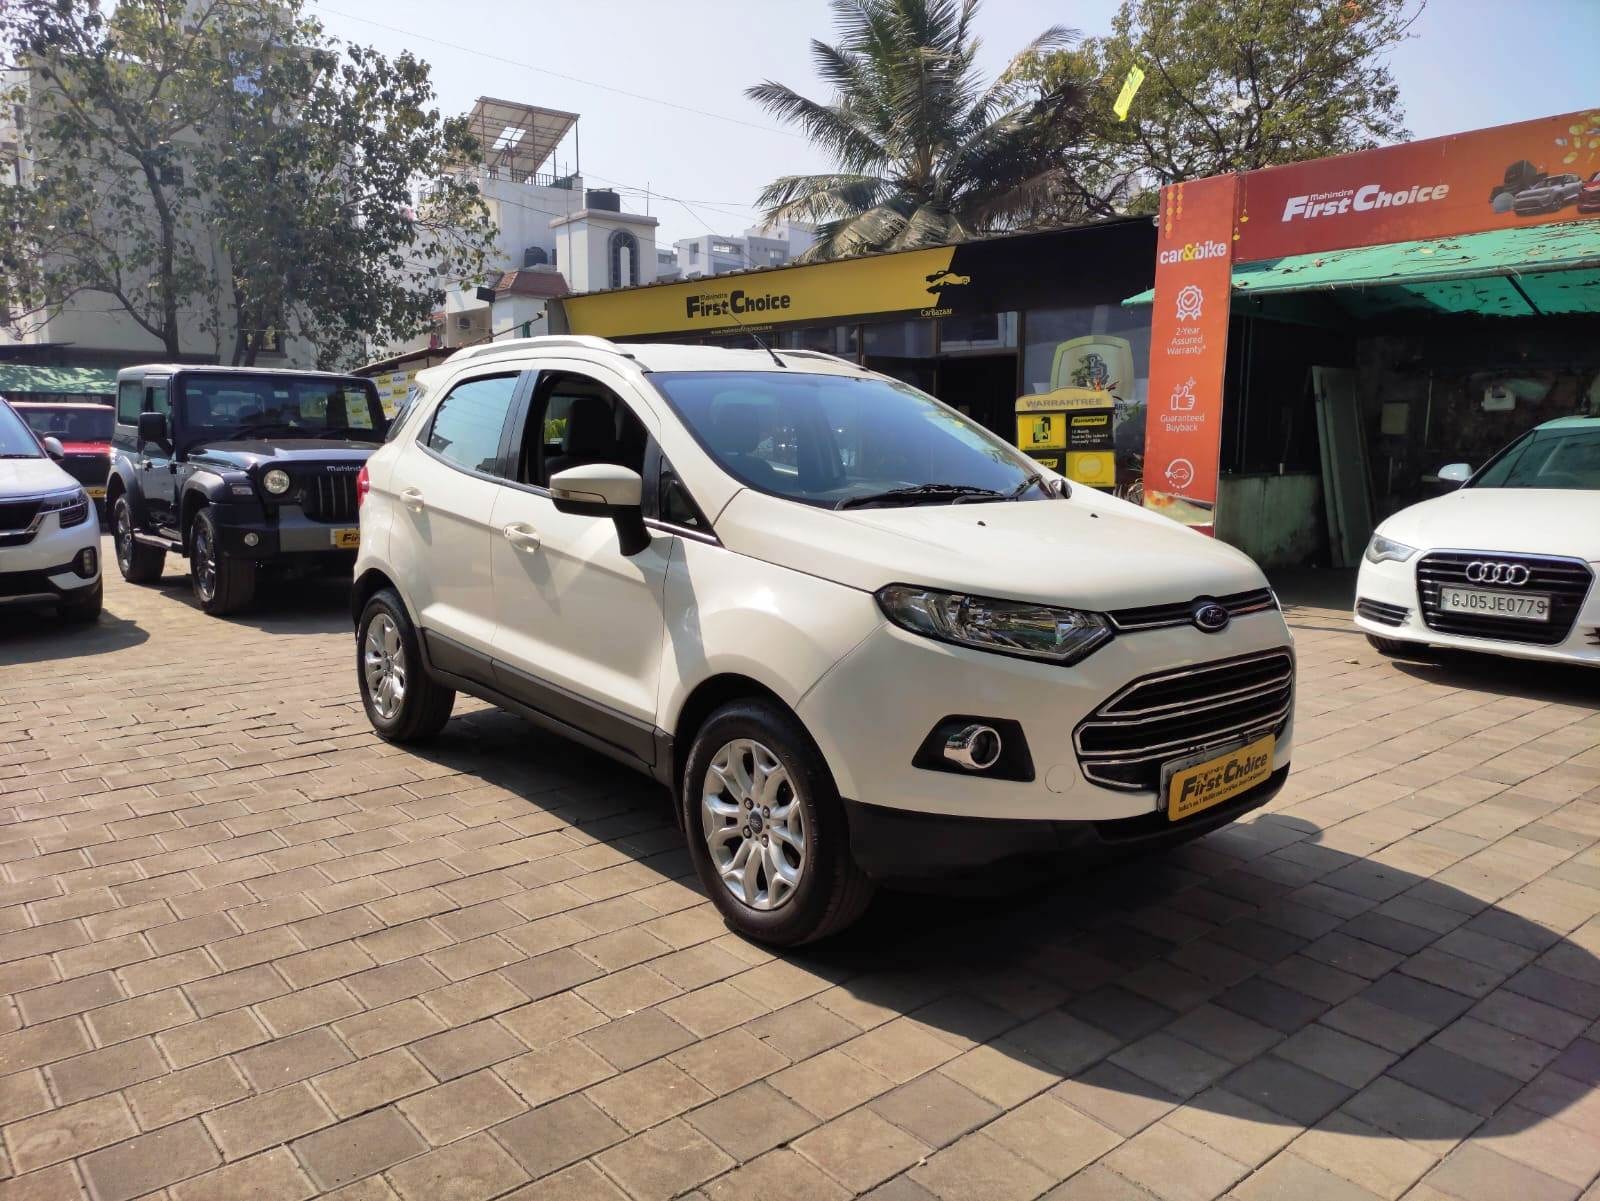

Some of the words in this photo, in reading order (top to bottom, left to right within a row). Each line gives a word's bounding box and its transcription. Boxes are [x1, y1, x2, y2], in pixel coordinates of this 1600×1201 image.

[1310, 189, 1354, 201] Mahindra
[1281, 195, 1352, 222] First
[1353, 184, 1449, 211] Choice
[1160, 240, 1227, 264] car&bike
[686, 295, 729, 318] First
[730, 290, 791, 314] Choice
[1176, 327, 1200, 336] 2-Year
[1171, 336, 1203, 345] Assured
[1160, 414, 1205, 423] Guaranteed
[1166, 423, 1199, 433] Buyback
[326, 465, 361, 473] Mahind
[1451, 592, 1545, 615] GJ05JE0779
[1180, 772, 1222, 803] First
[1223, 753, 1268, 784] Choice
